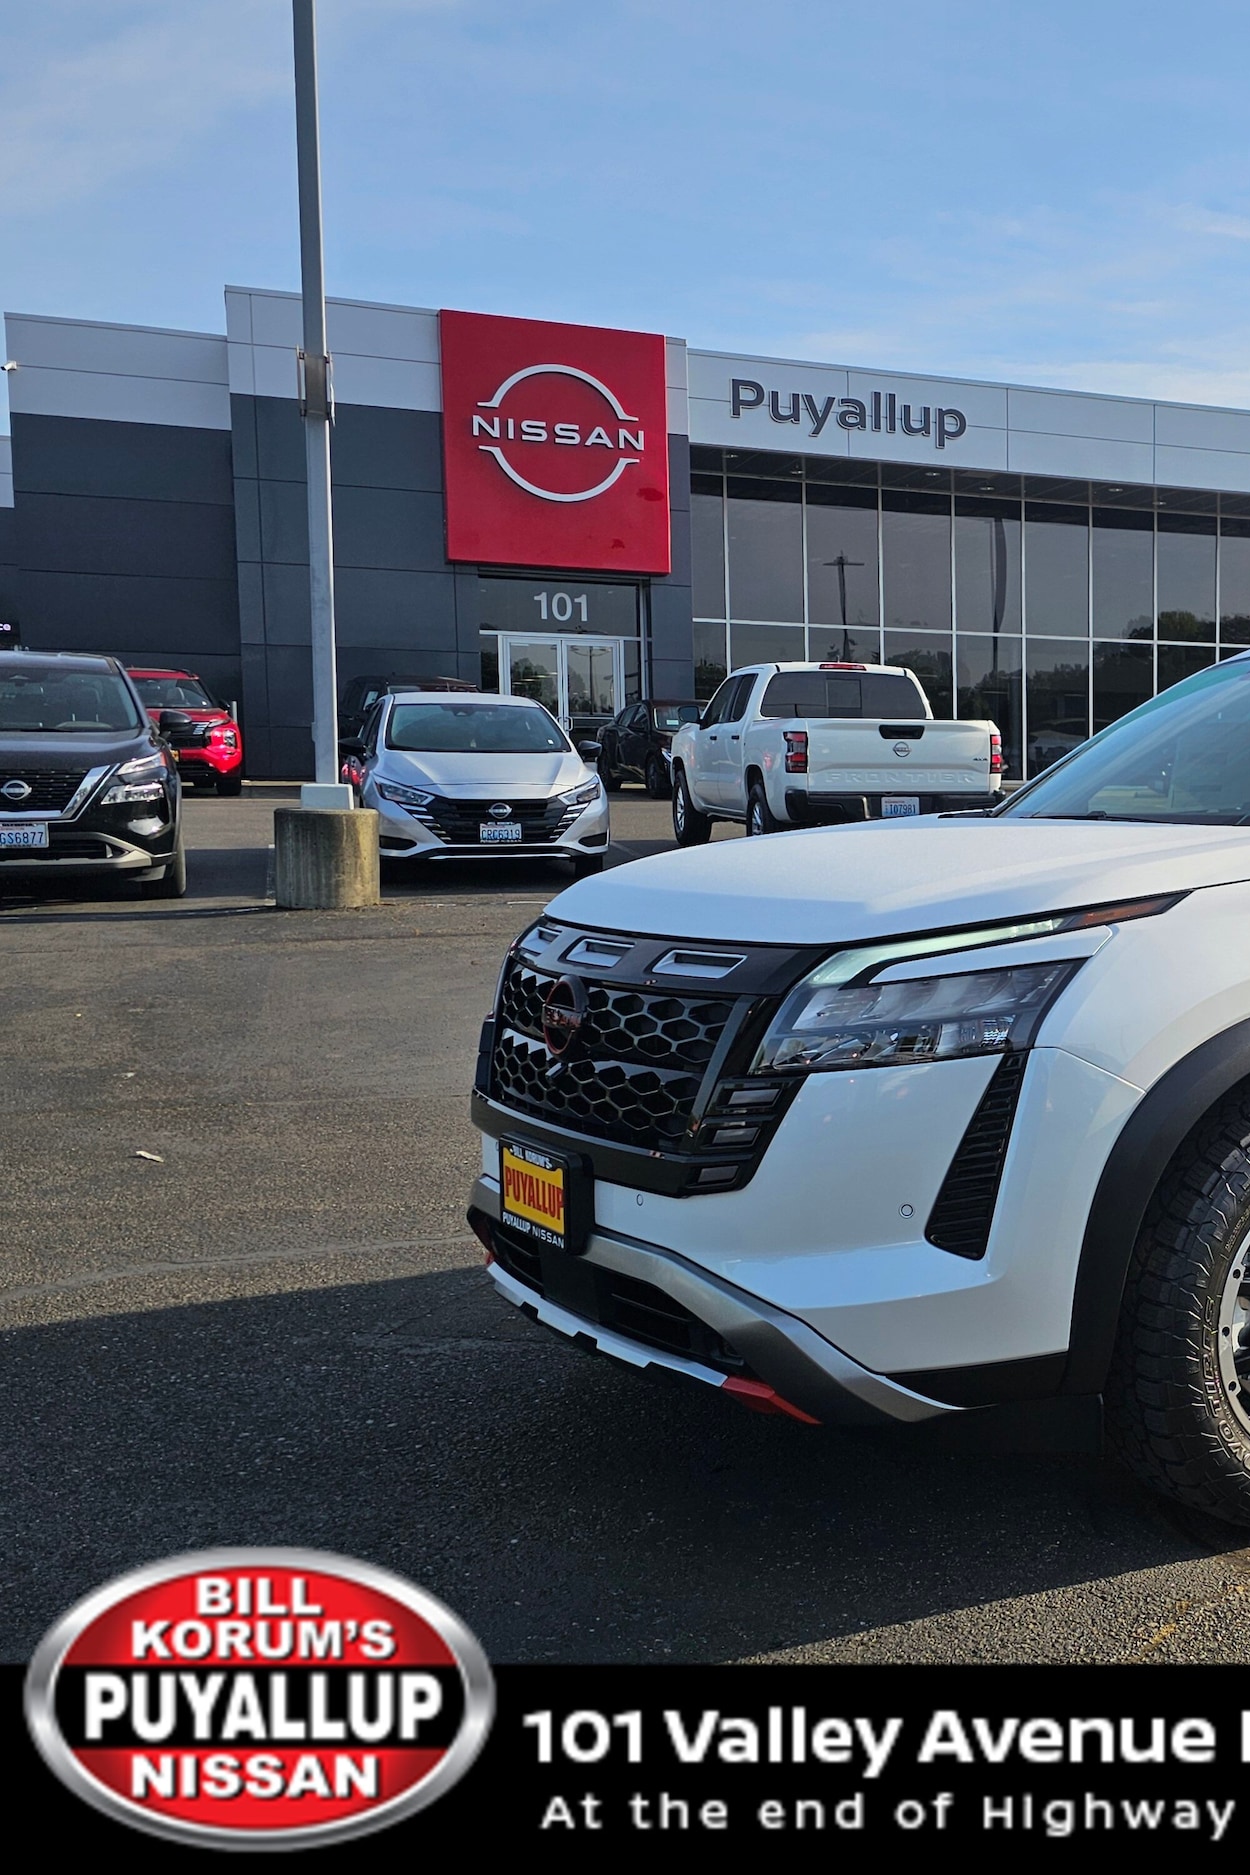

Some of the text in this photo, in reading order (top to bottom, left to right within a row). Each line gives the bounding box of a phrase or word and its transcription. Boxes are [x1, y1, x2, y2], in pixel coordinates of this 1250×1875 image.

[730, 377, 967, 449] Puyallup
[472, 414, 645, 451] NISSAN
[533, 591, 588, 622] 101
[824, 771, 976, 784] FRONTIER
[504, 1164, 566, 1221] PUYALLUP
[502, 1210, 565, 1250] PUYALLUP NISSAN
